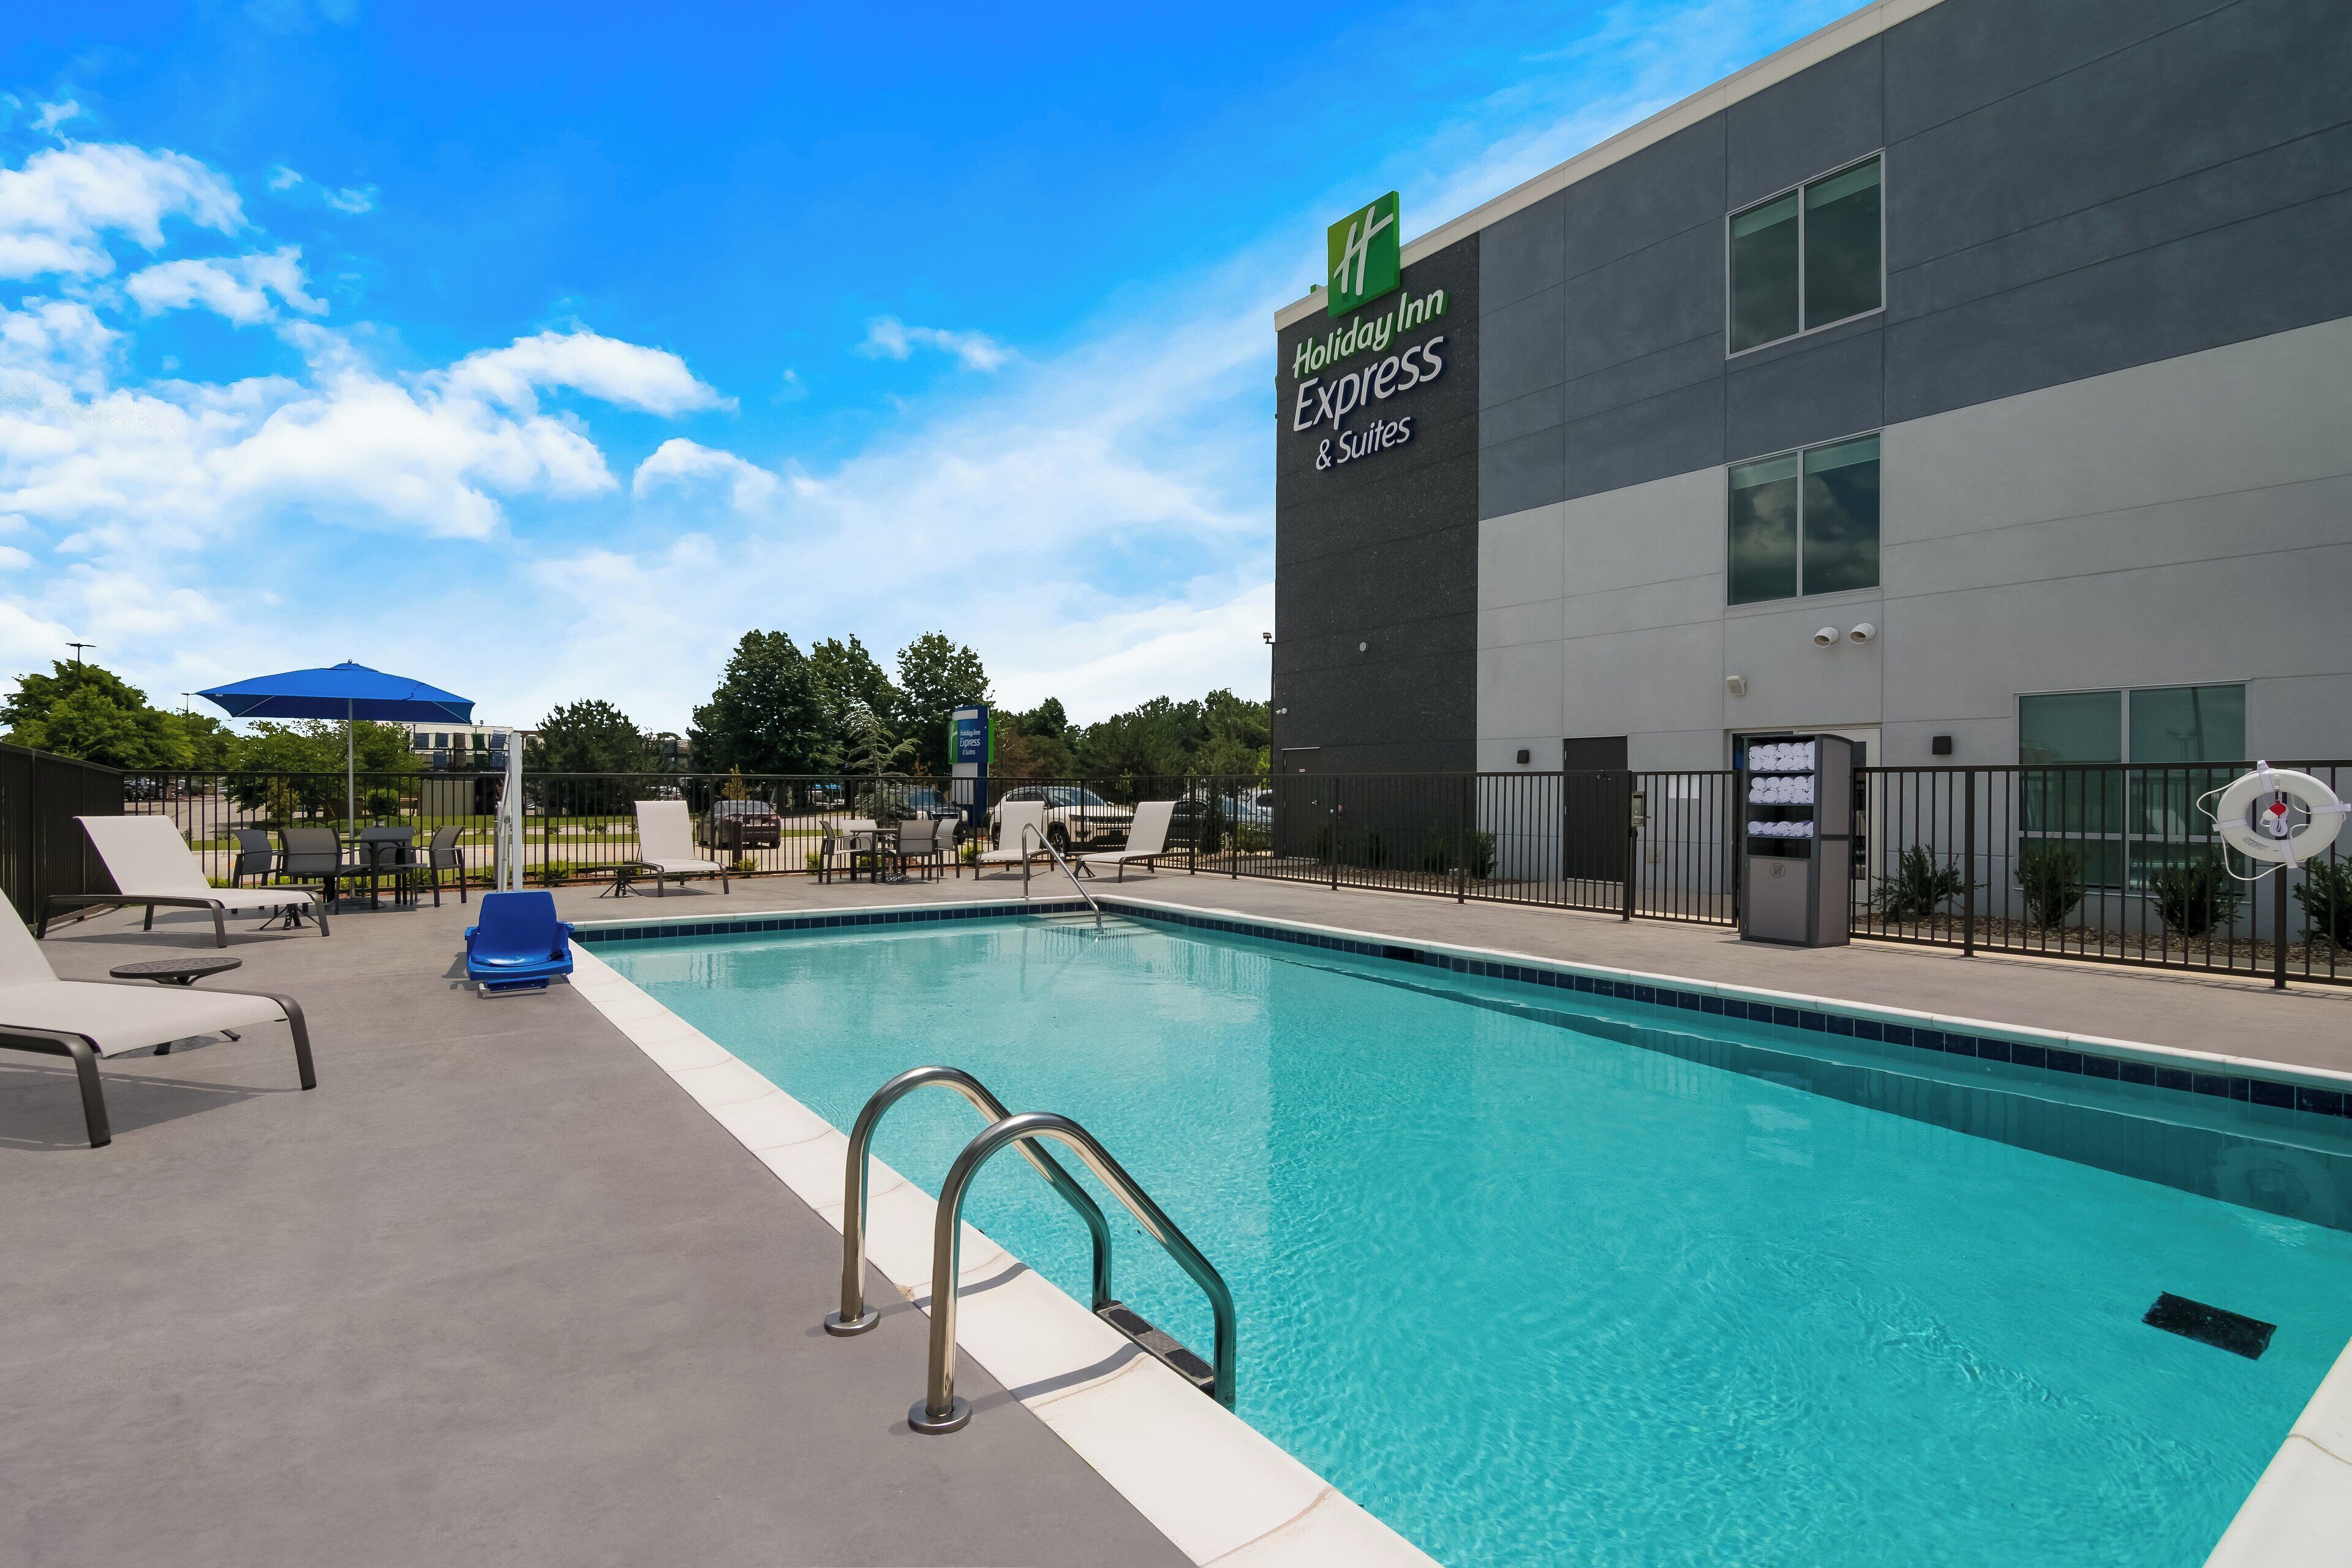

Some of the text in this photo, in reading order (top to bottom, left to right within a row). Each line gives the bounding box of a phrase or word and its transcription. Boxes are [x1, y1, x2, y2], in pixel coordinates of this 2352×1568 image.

[1333, 206, 1393, 296] H
[1292, 289, 1444, 379] Holiday Inn
[1293, 336, 1444, 431] Express
[1316, 417, 1411, 470] & Suites
[960, 738, 981, 748] Express
